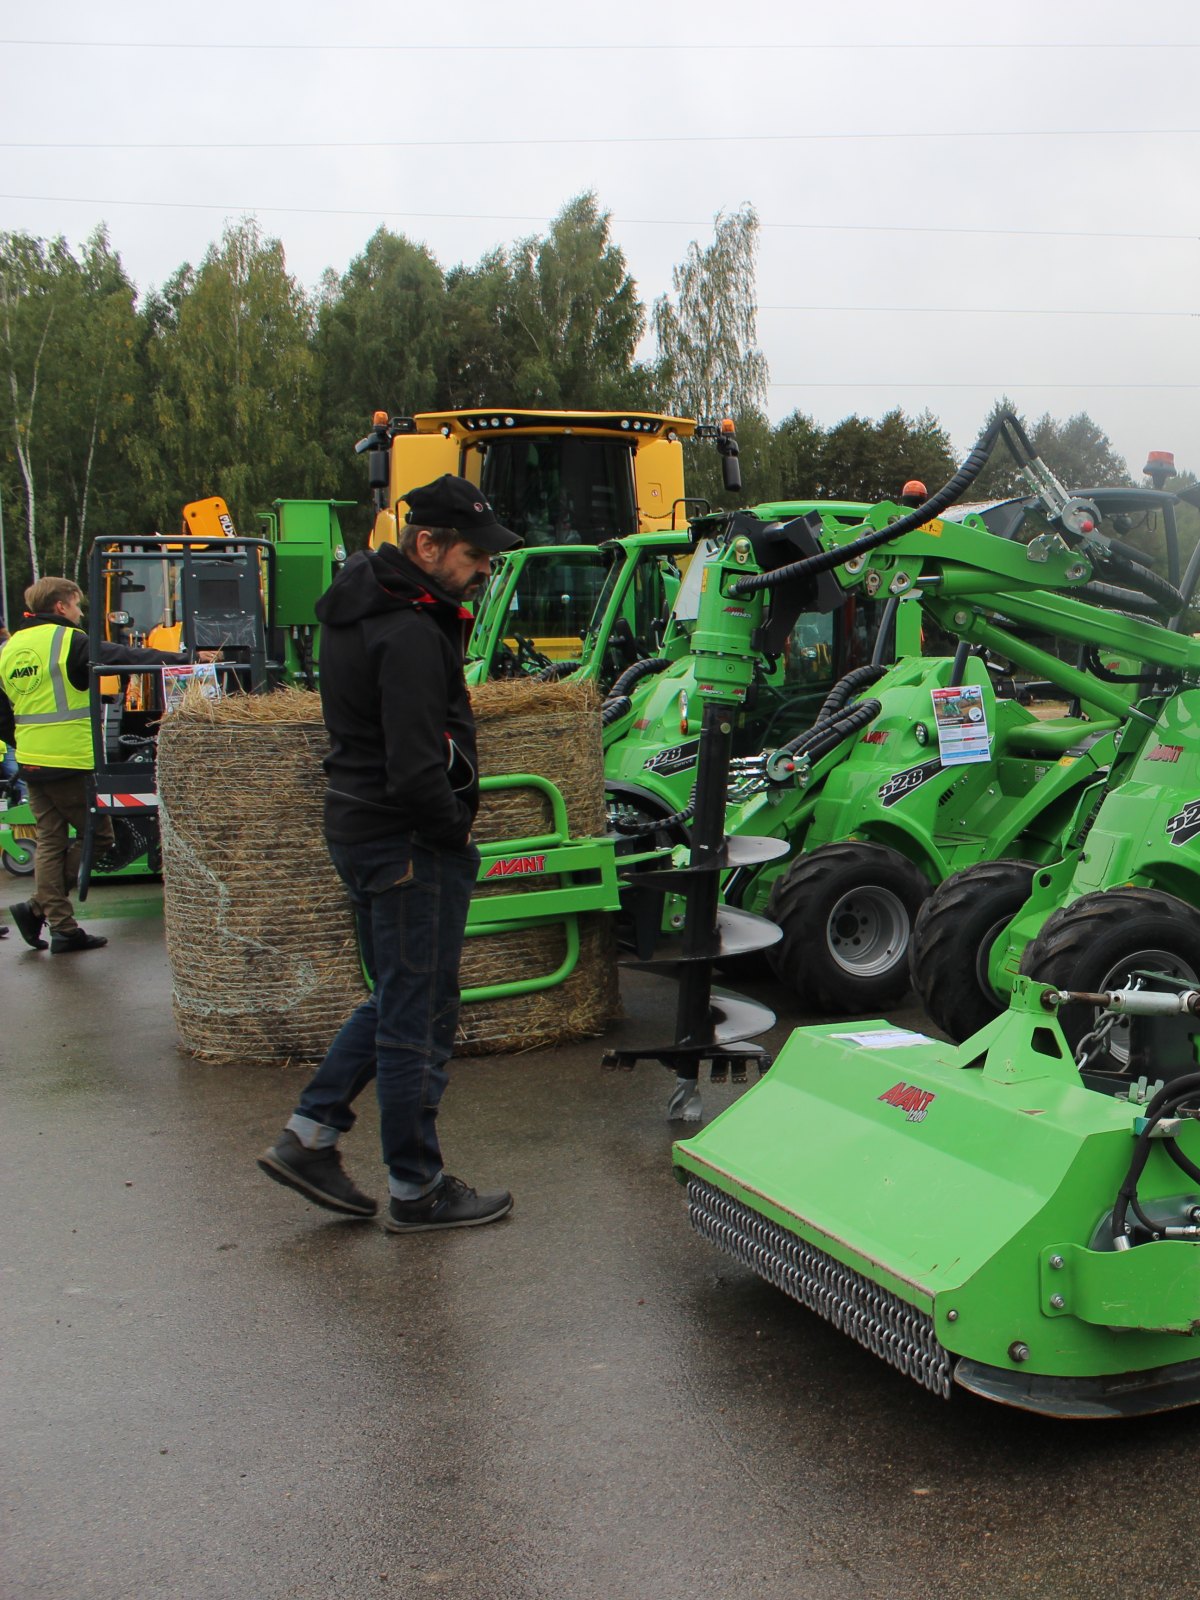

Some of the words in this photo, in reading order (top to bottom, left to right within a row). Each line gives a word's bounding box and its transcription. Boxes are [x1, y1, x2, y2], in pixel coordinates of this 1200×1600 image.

[642, 746, 682, 771] 528
[878, 768, 923, 798] 528
[482, 854, 546, 878] AVANT
[877, 1081, 937, 1113] AVANT
[905, 1108, 929, 1123] 1200
